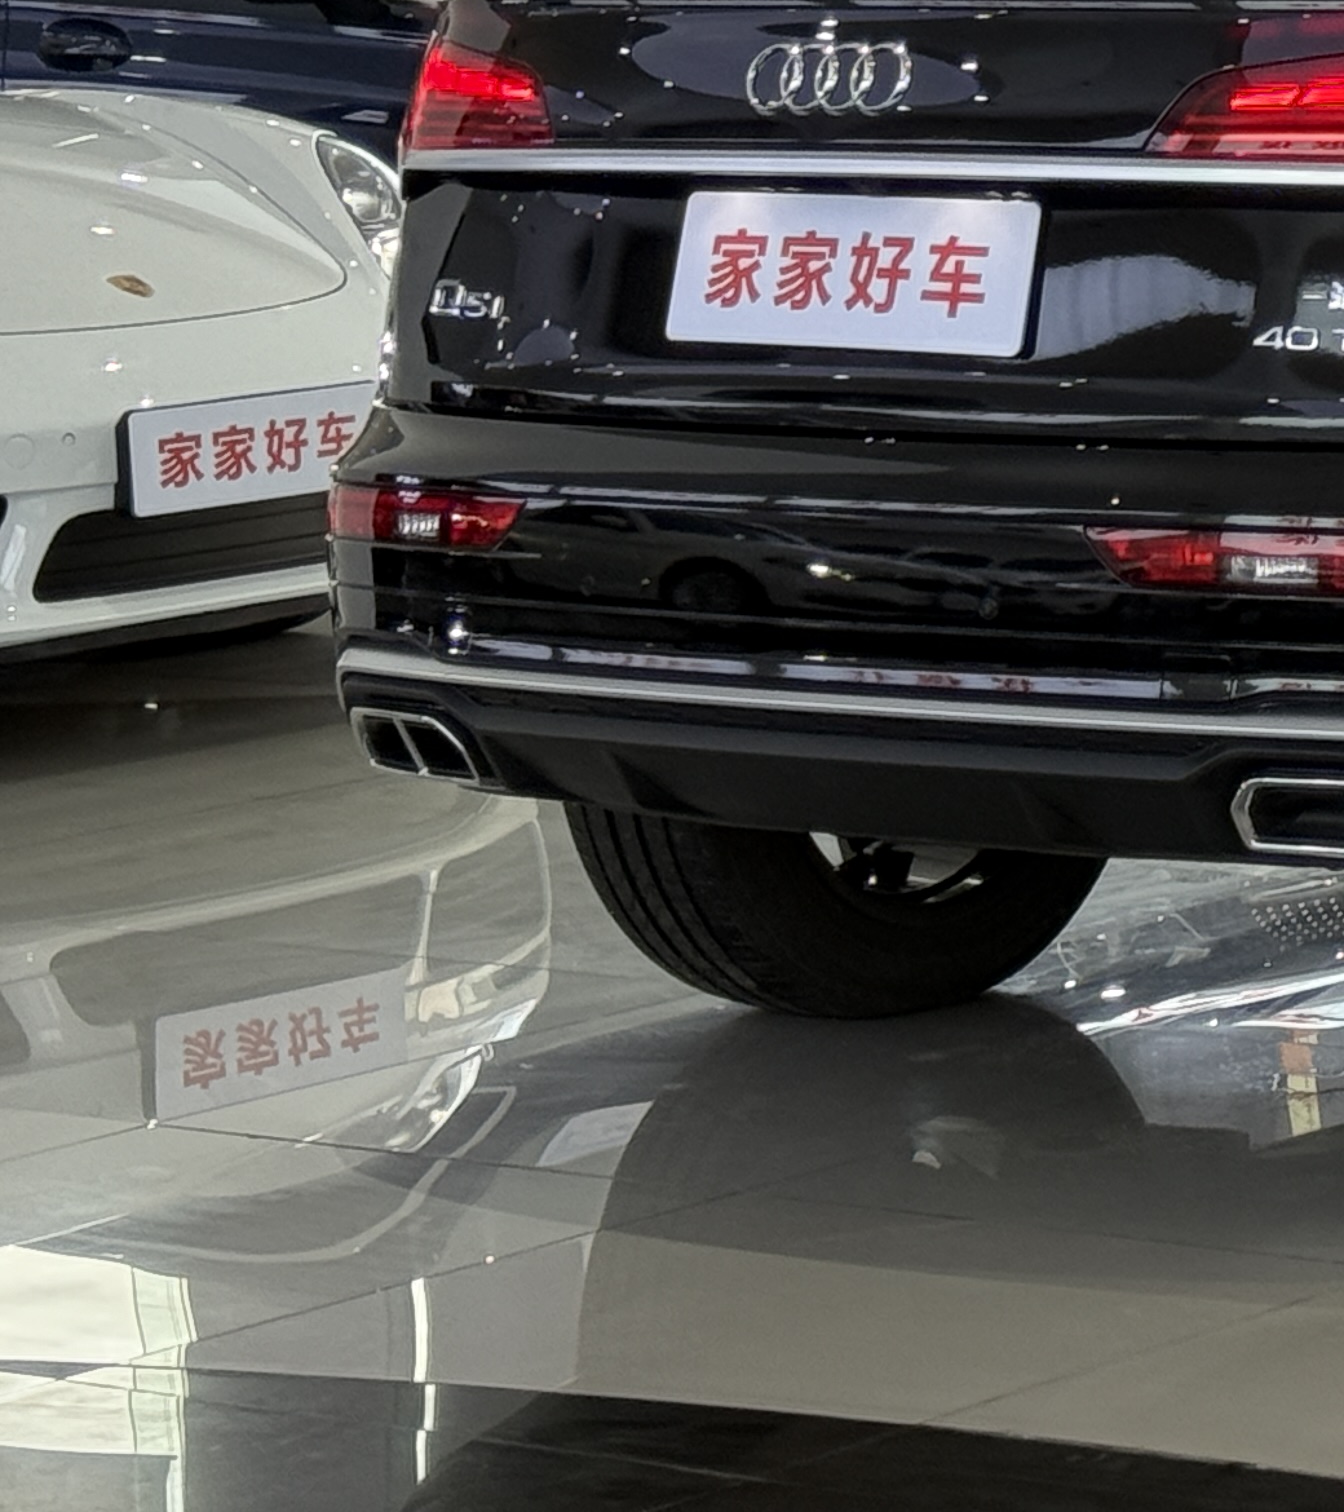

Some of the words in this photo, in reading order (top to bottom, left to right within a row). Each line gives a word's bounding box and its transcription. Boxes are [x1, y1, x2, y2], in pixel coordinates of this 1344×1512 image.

[704, 228, 990, 318] 家家好车
[1253, 325, 1320, 351] 40
[157, 410, 357, 490] 家家好车
